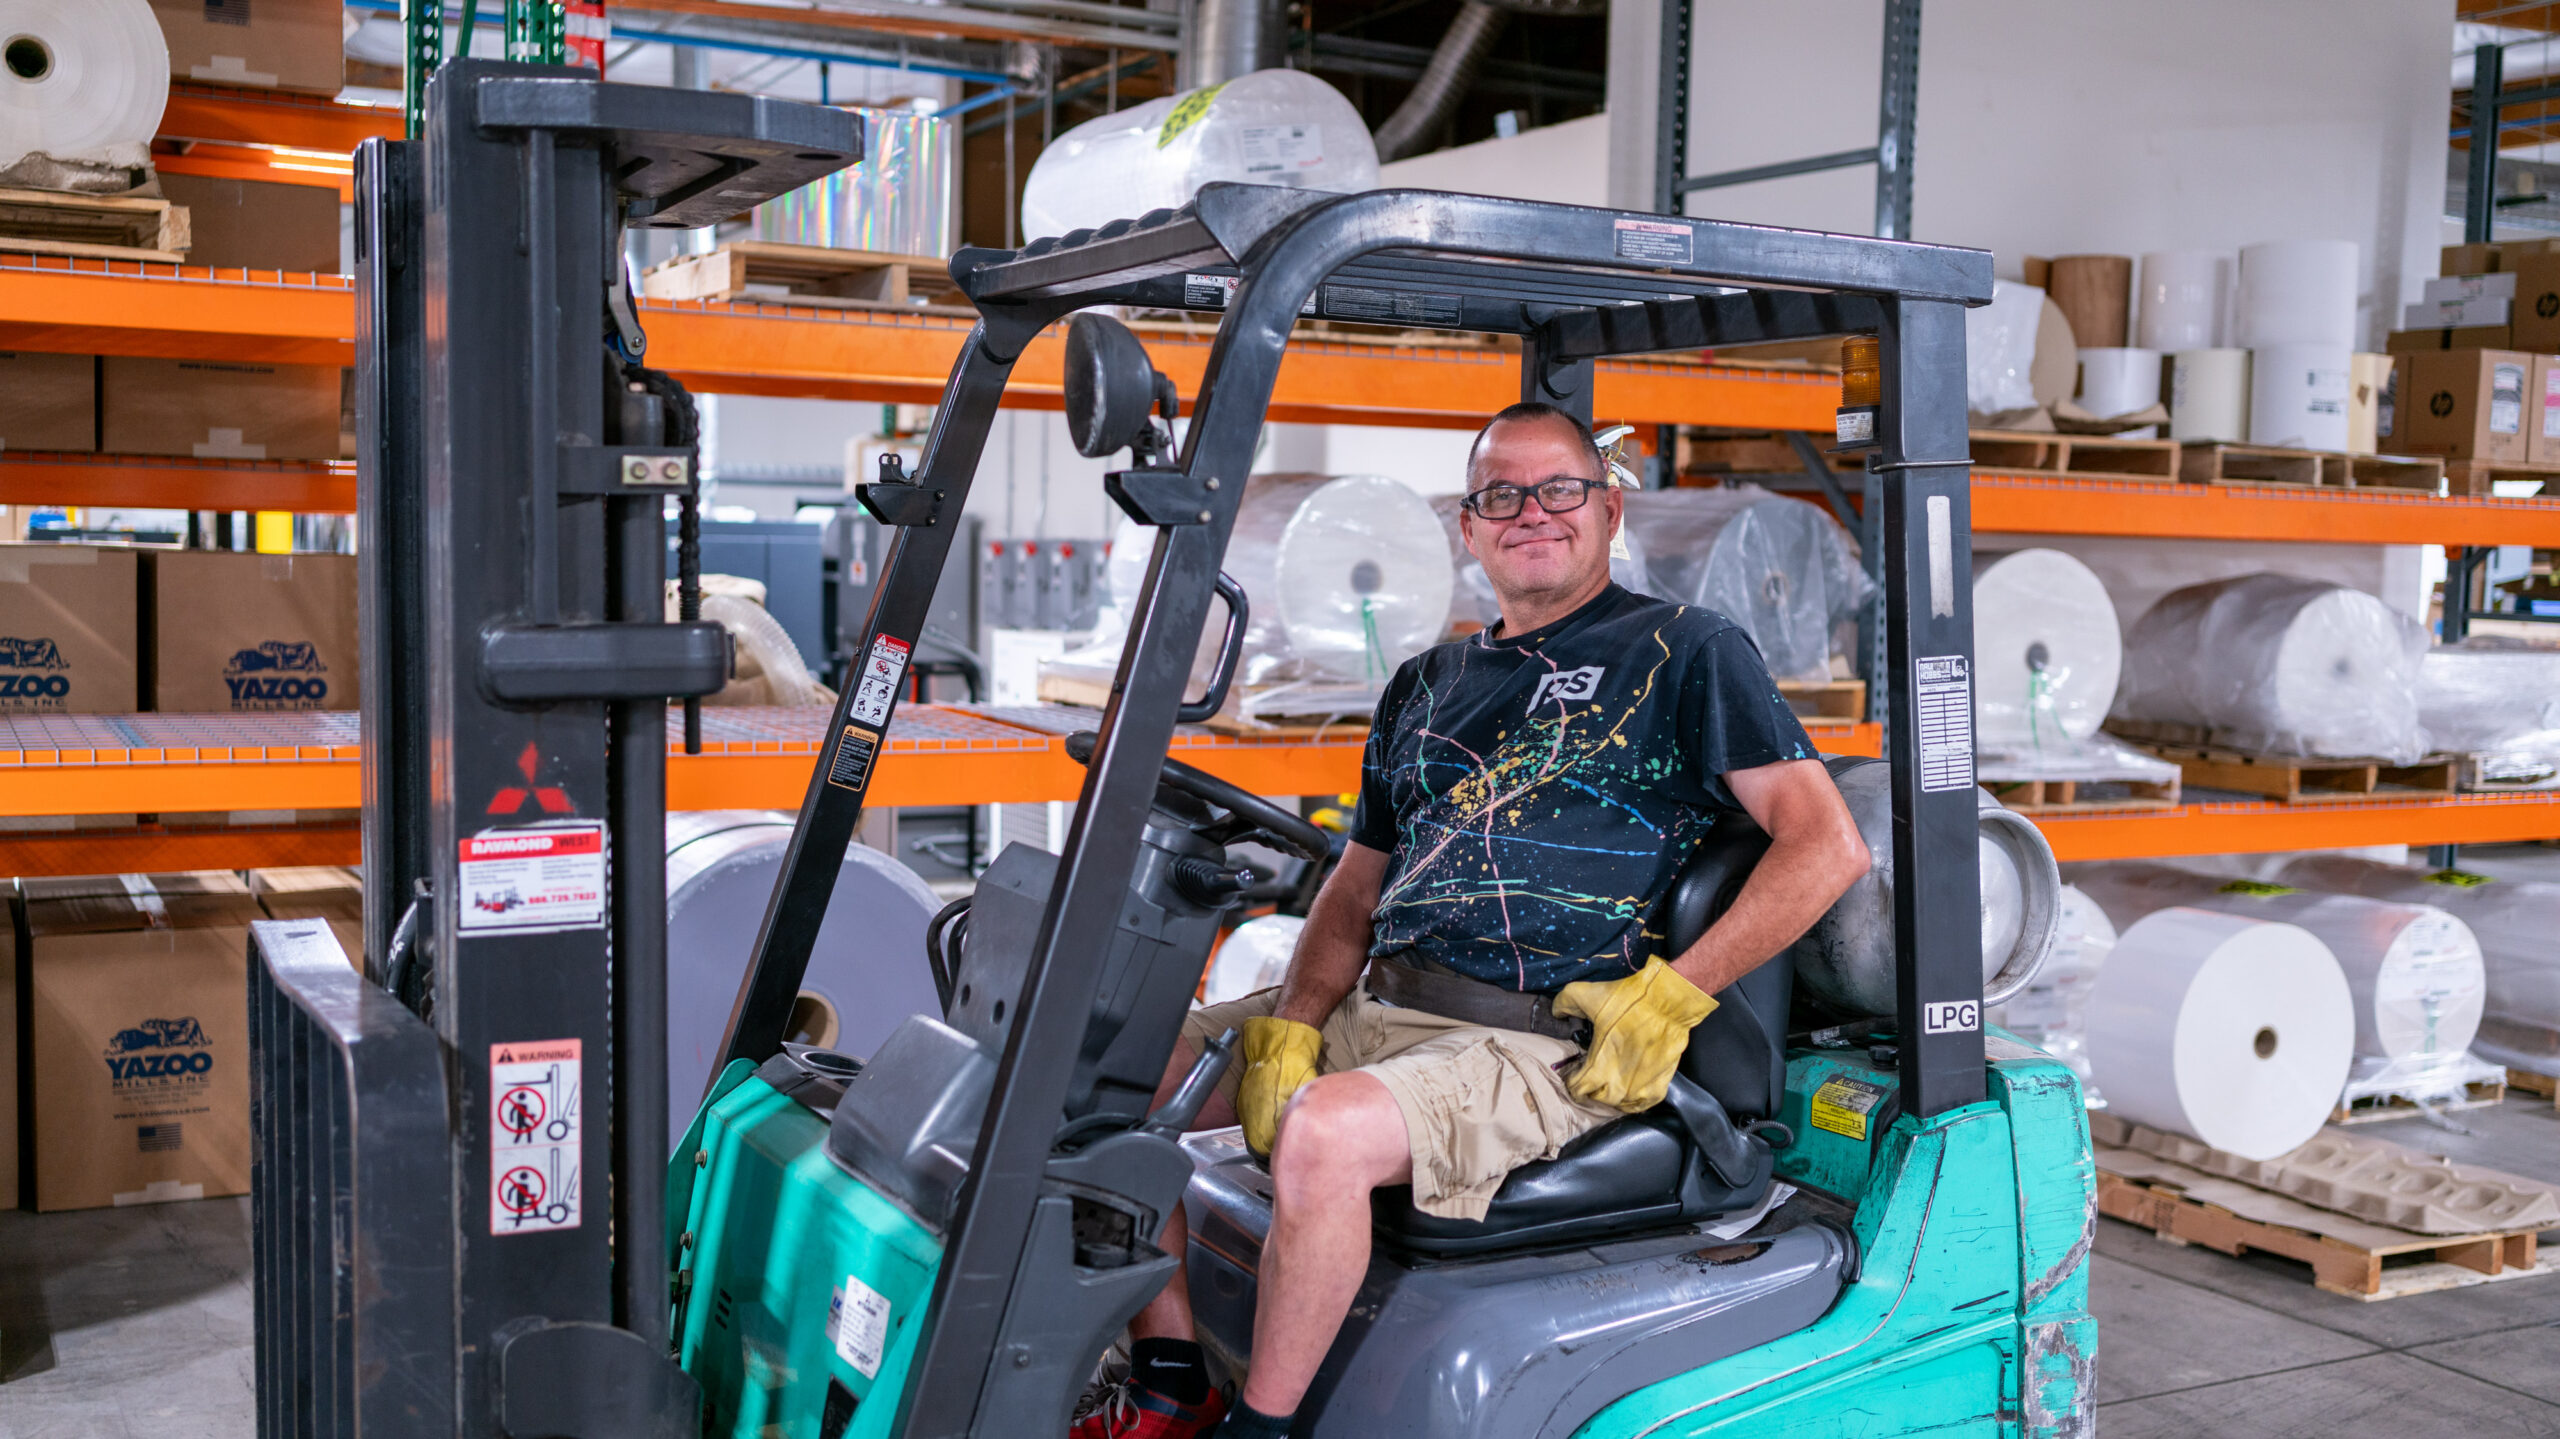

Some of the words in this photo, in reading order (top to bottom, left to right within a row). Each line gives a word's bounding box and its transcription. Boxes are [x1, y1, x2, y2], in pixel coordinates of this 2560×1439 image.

[1640, 224, 1672, 233] WARNING
[887, 642, 907, 653] DANGER
[224, 678, 327, 700] YAZOO
[854, 731, 876, 742] WARNING
[471, 837, 554, 854] RAYMOND
[559, 836, 590, 847] WEST
[1928, 1004, 1976, 1030] LPG
[518, 1049, 574, 1061] WARNING
[105, 1052, 213, 1080] YAZOO
[112, 1076, 168, 1089] MILLS
[178, 1073, 208, 1084] INC
[1844, 1080, 1876, 1093] CAUTION
